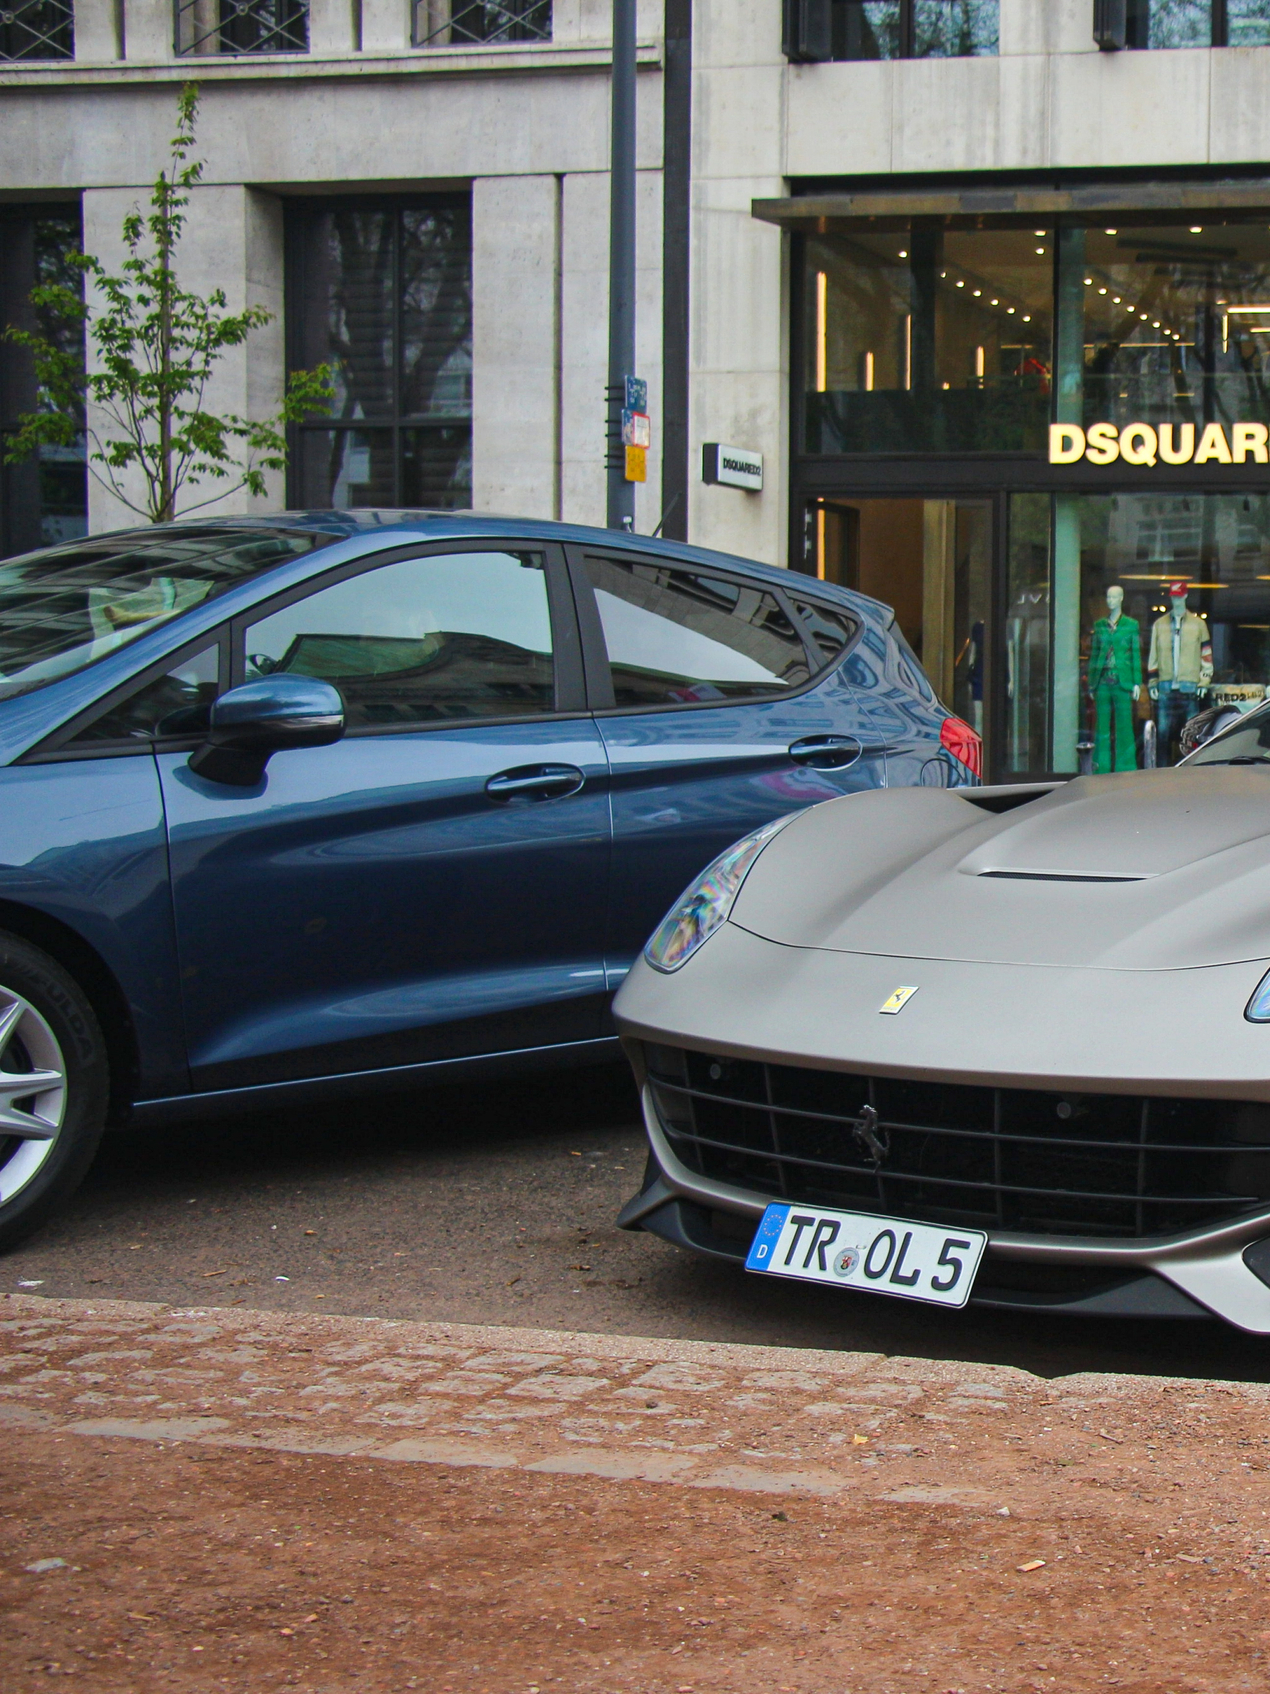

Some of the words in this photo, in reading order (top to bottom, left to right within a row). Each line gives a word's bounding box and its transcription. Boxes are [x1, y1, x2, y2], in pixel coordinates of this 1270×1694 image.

[723, 457, 762, 477] DSQUARED2
[756, 1244, 769, 1259] D
[784, 1214, 841, 1271] TR
[930, 1238, 971, 1292] 5
